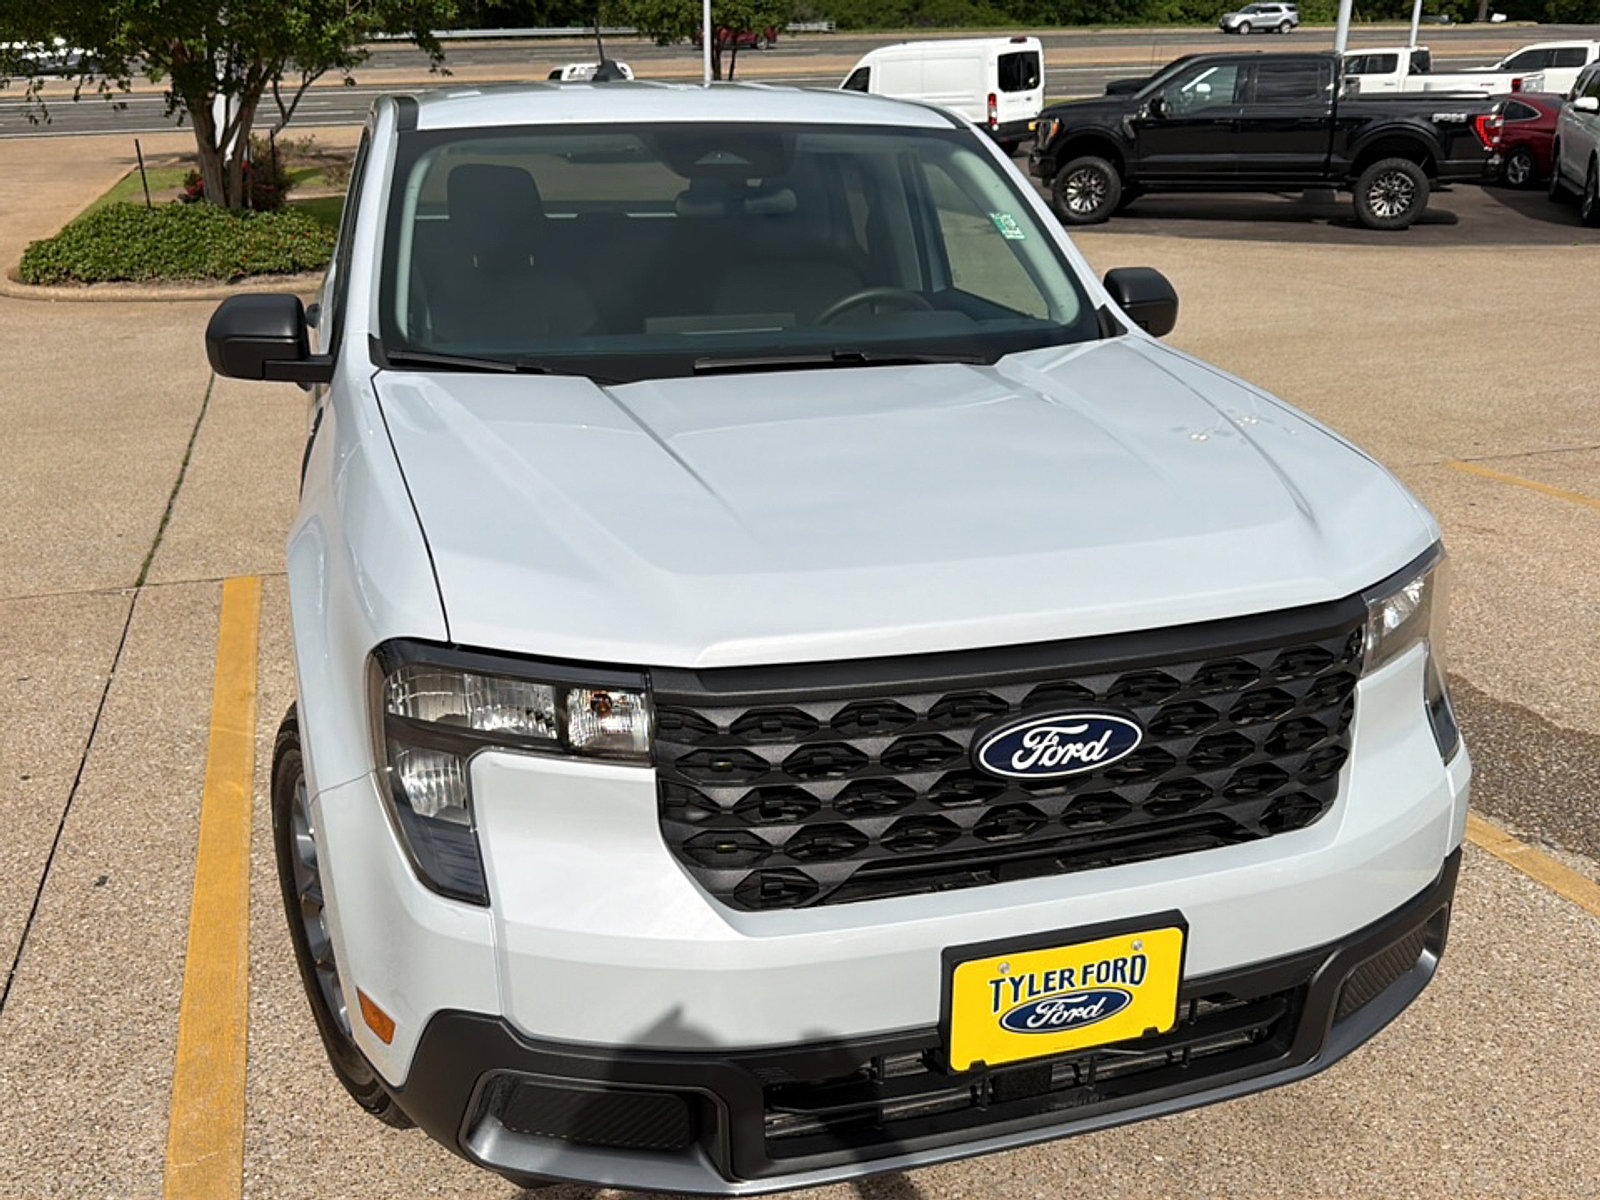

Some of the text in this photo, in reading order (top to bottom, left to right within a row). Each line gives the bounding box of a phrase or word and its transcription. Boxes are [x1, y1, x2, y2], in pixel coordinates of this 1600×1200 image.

[1011, 723, 1113, 770] Ford
[989, 954, 1147, 1013] TYLER FORD
[1026, 995, 1107, 1028] Ford
